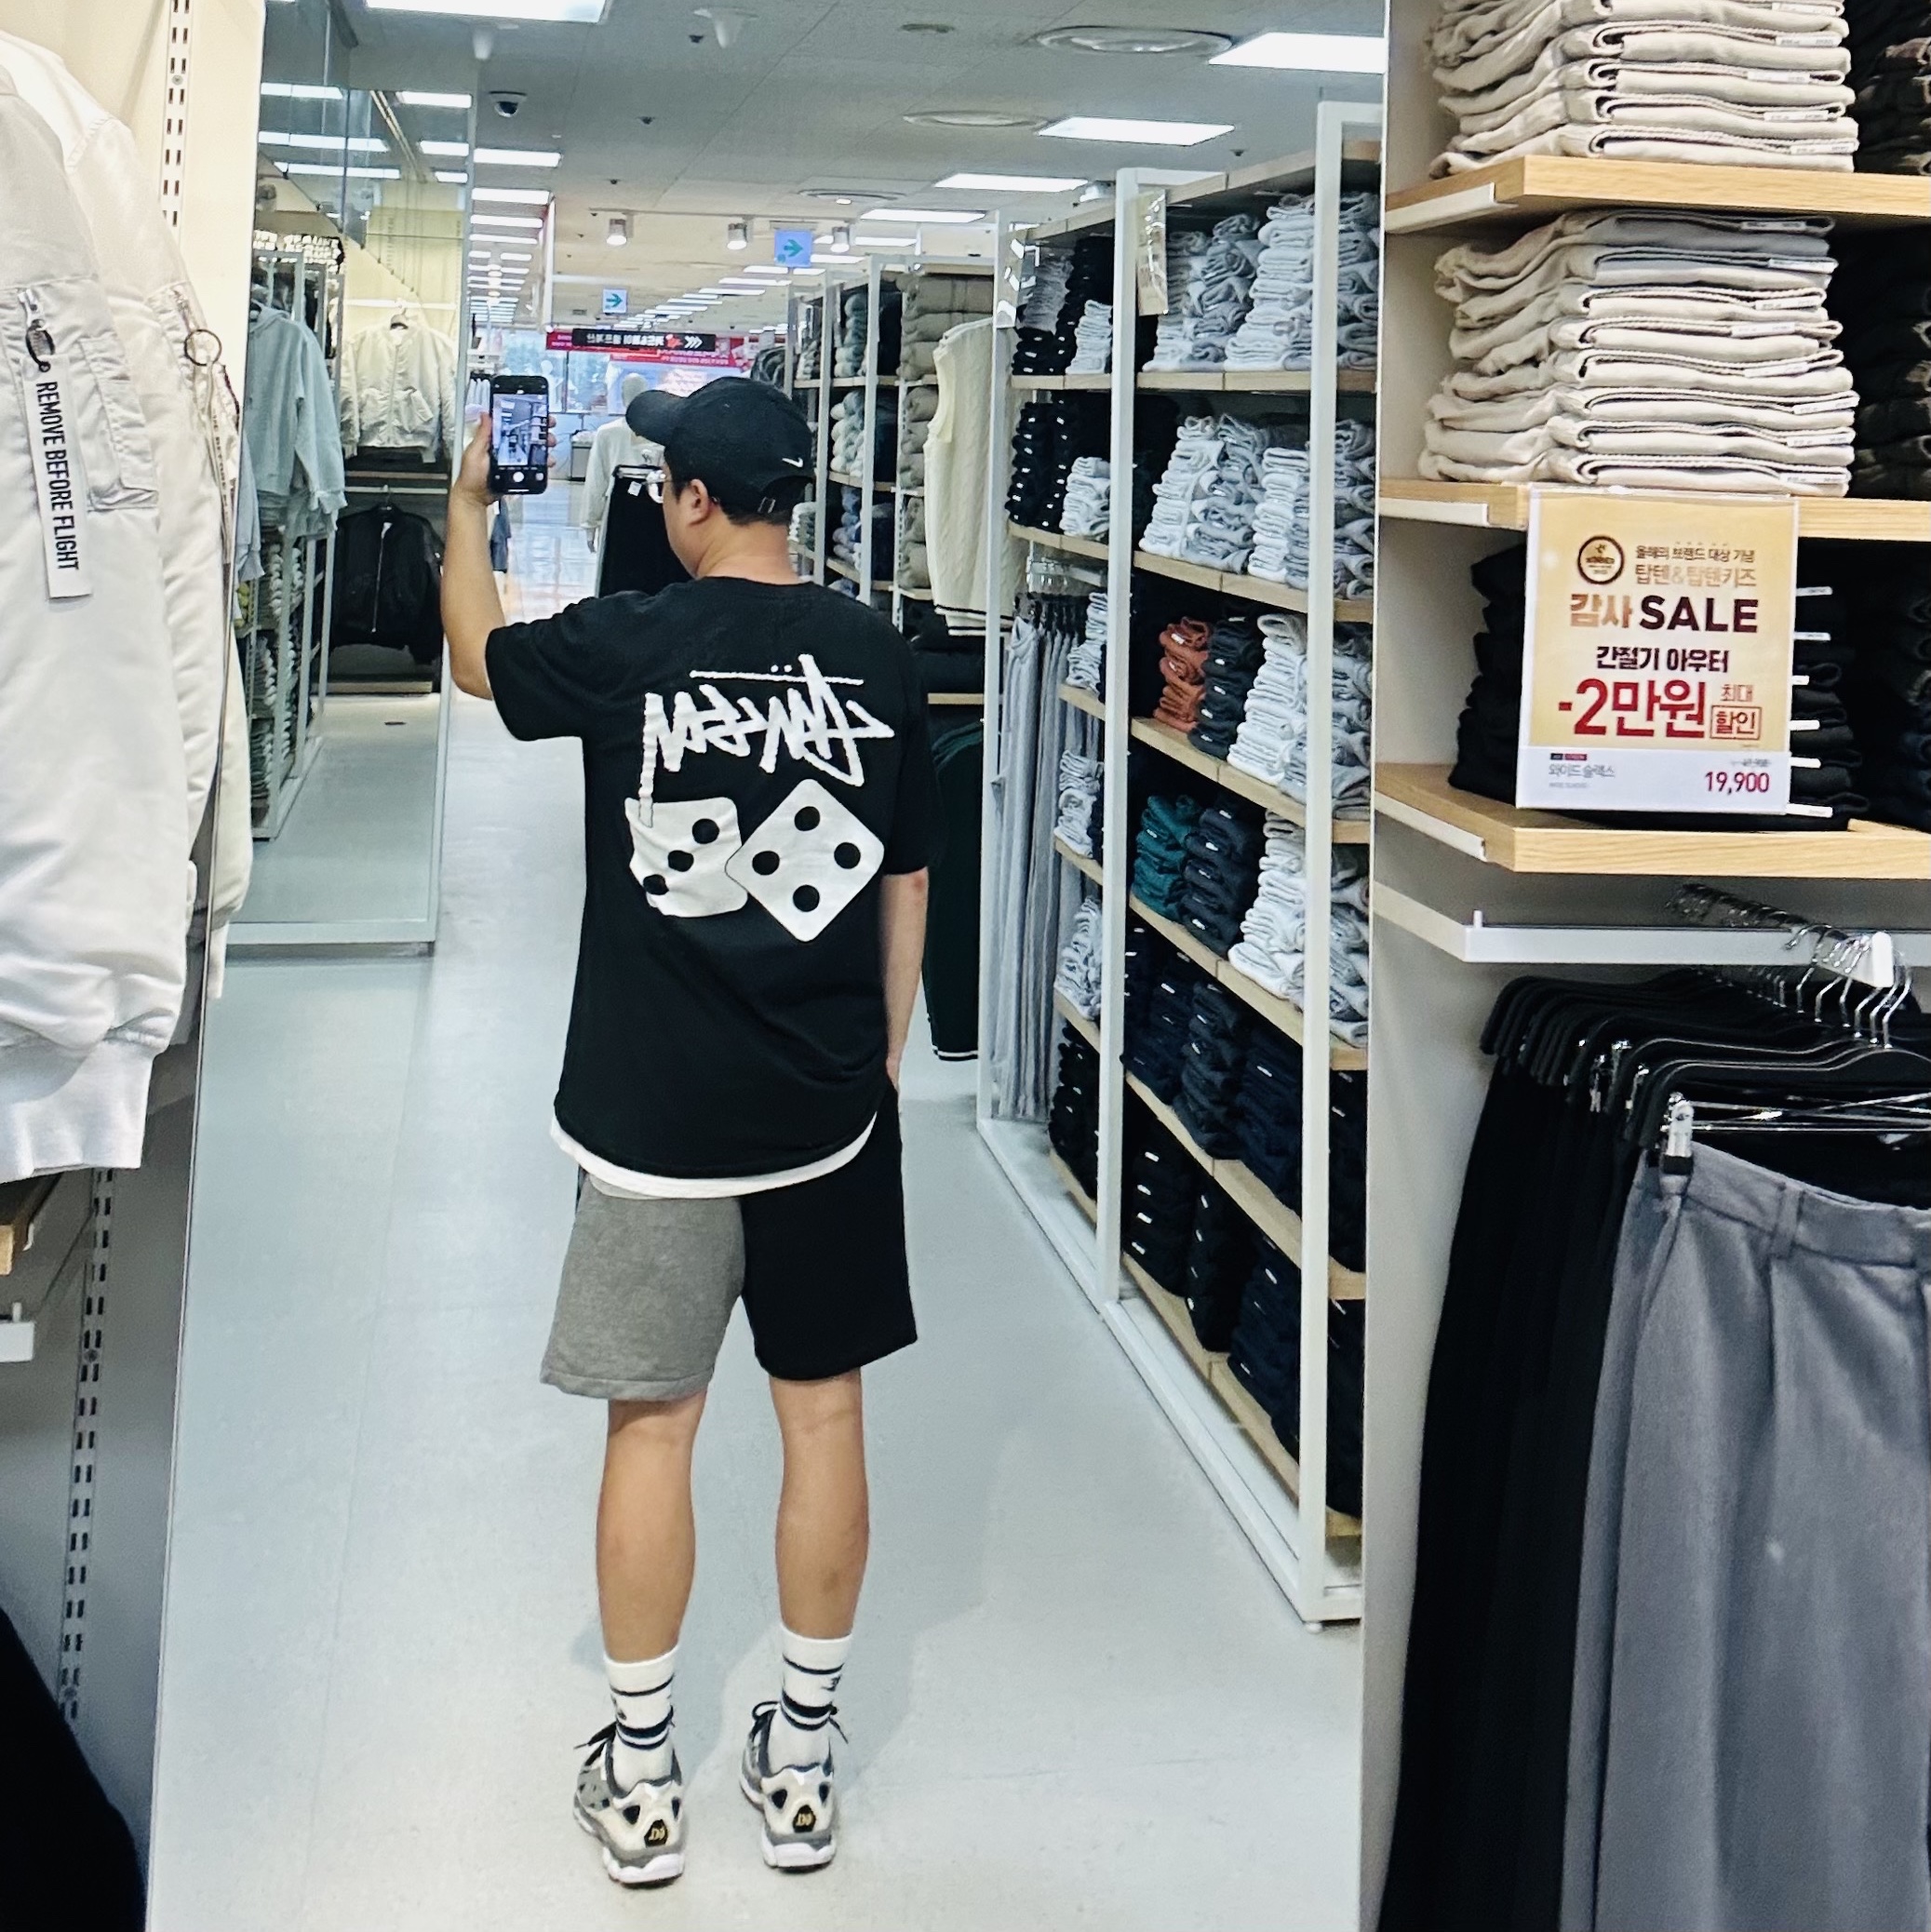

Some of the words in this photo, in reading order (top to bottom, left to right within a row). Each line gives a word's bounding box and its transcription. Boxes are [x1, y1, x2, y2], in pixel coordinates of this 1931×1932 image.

[35, 381, 65, 446] REMOVE
[45, 449, 74, 510] BEFORE
[52, 515, 79, 570] FLIGHT
[1671, 545, 1705, 562] 브랜드
[1709, 548, 1731, 563] 대상
[1733, 549, 1755, 564] 기념
[1570, 593, 1633, 628] 감사
[1639, 595, 1759, 634] SALE
[1596, 646, 1659, 671] 간절기
[1666, 649, 1730, 673] 아우터
[1558, 678, 1706, 738] -2만원
[1722, 683, 1754, 703] 최대
[1716, 710, 1756, 735] 할인
[1705, 771, 1770, 796] 19,900
